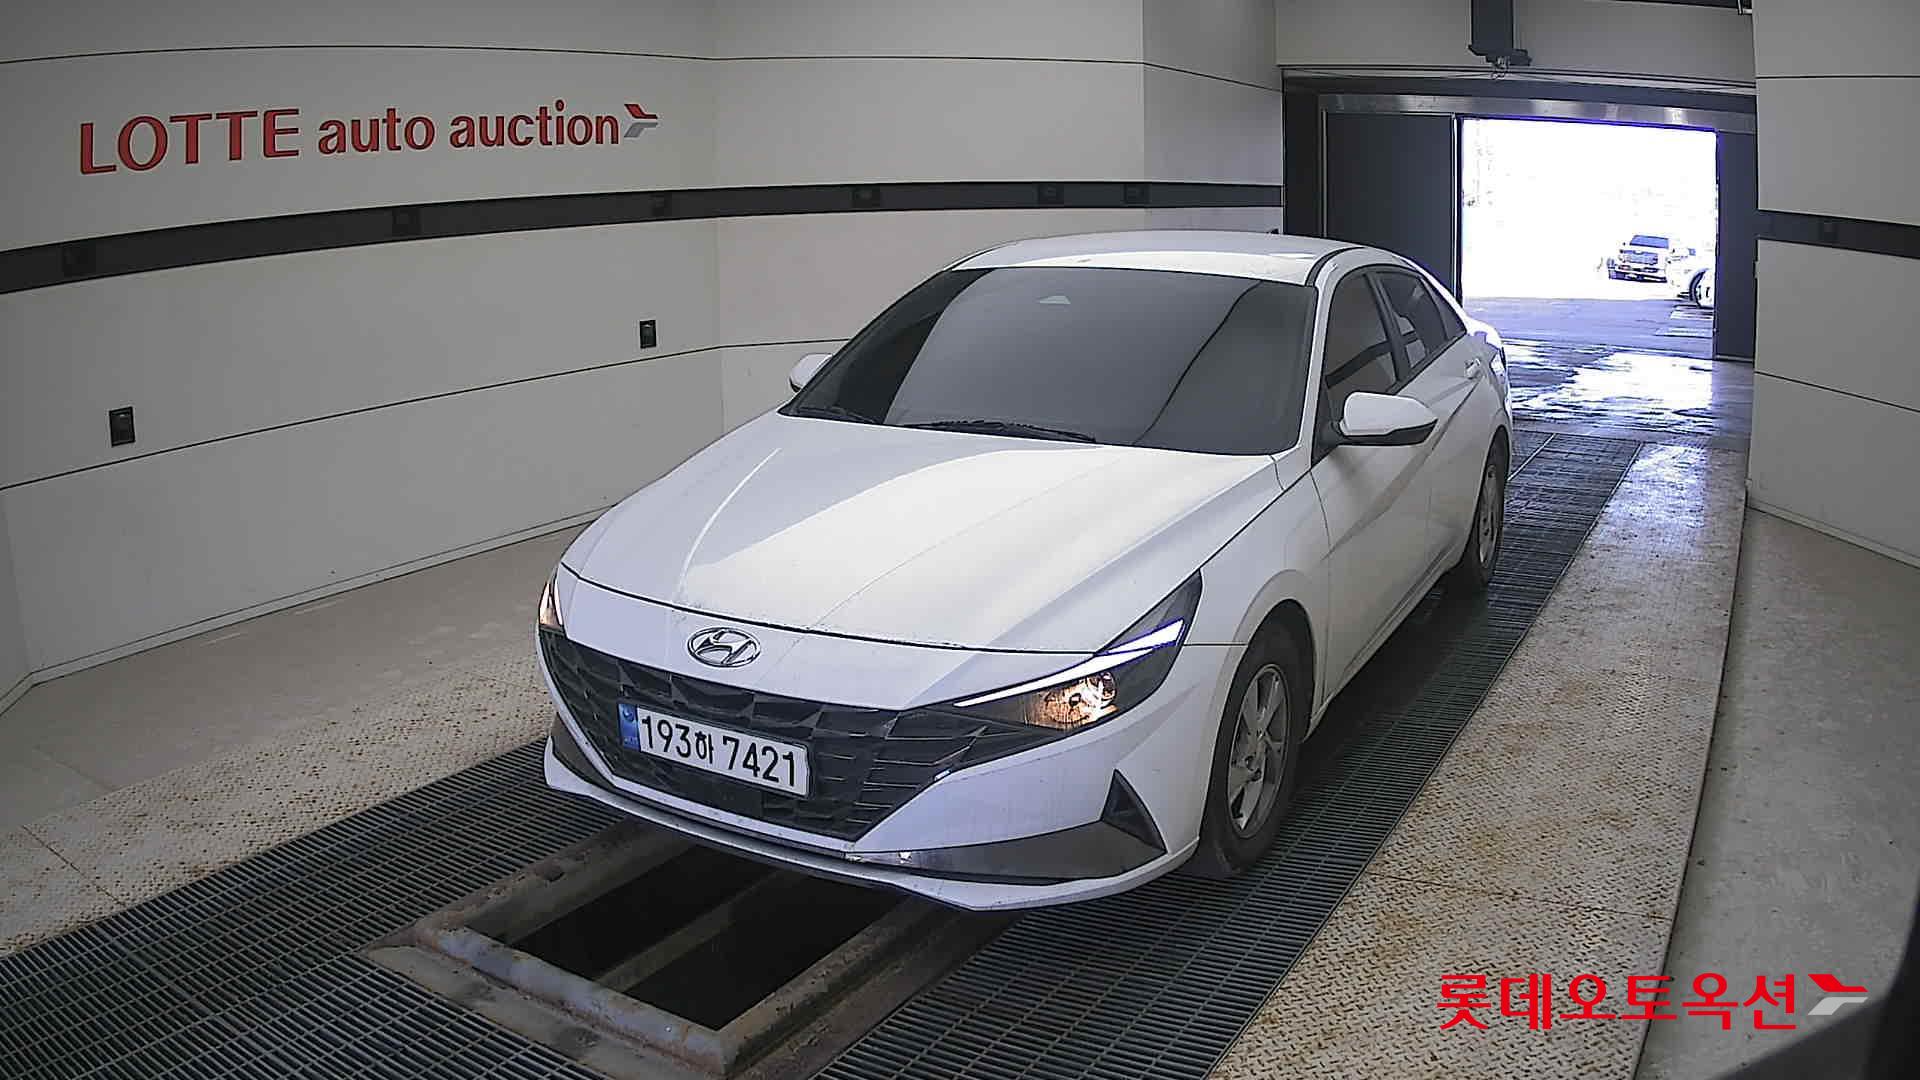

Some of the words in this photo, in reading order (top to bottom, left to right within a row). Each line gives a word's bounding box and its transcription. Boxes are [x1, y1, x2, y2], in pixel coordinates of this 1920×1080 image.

[80, 108, 299, 175] LOTTE
[317, 107, 435, 154] auto
[449, 99, 620, 148] auction
[641, 715, 714, 764] 193하
[722, 735, 796, 787] 7421
